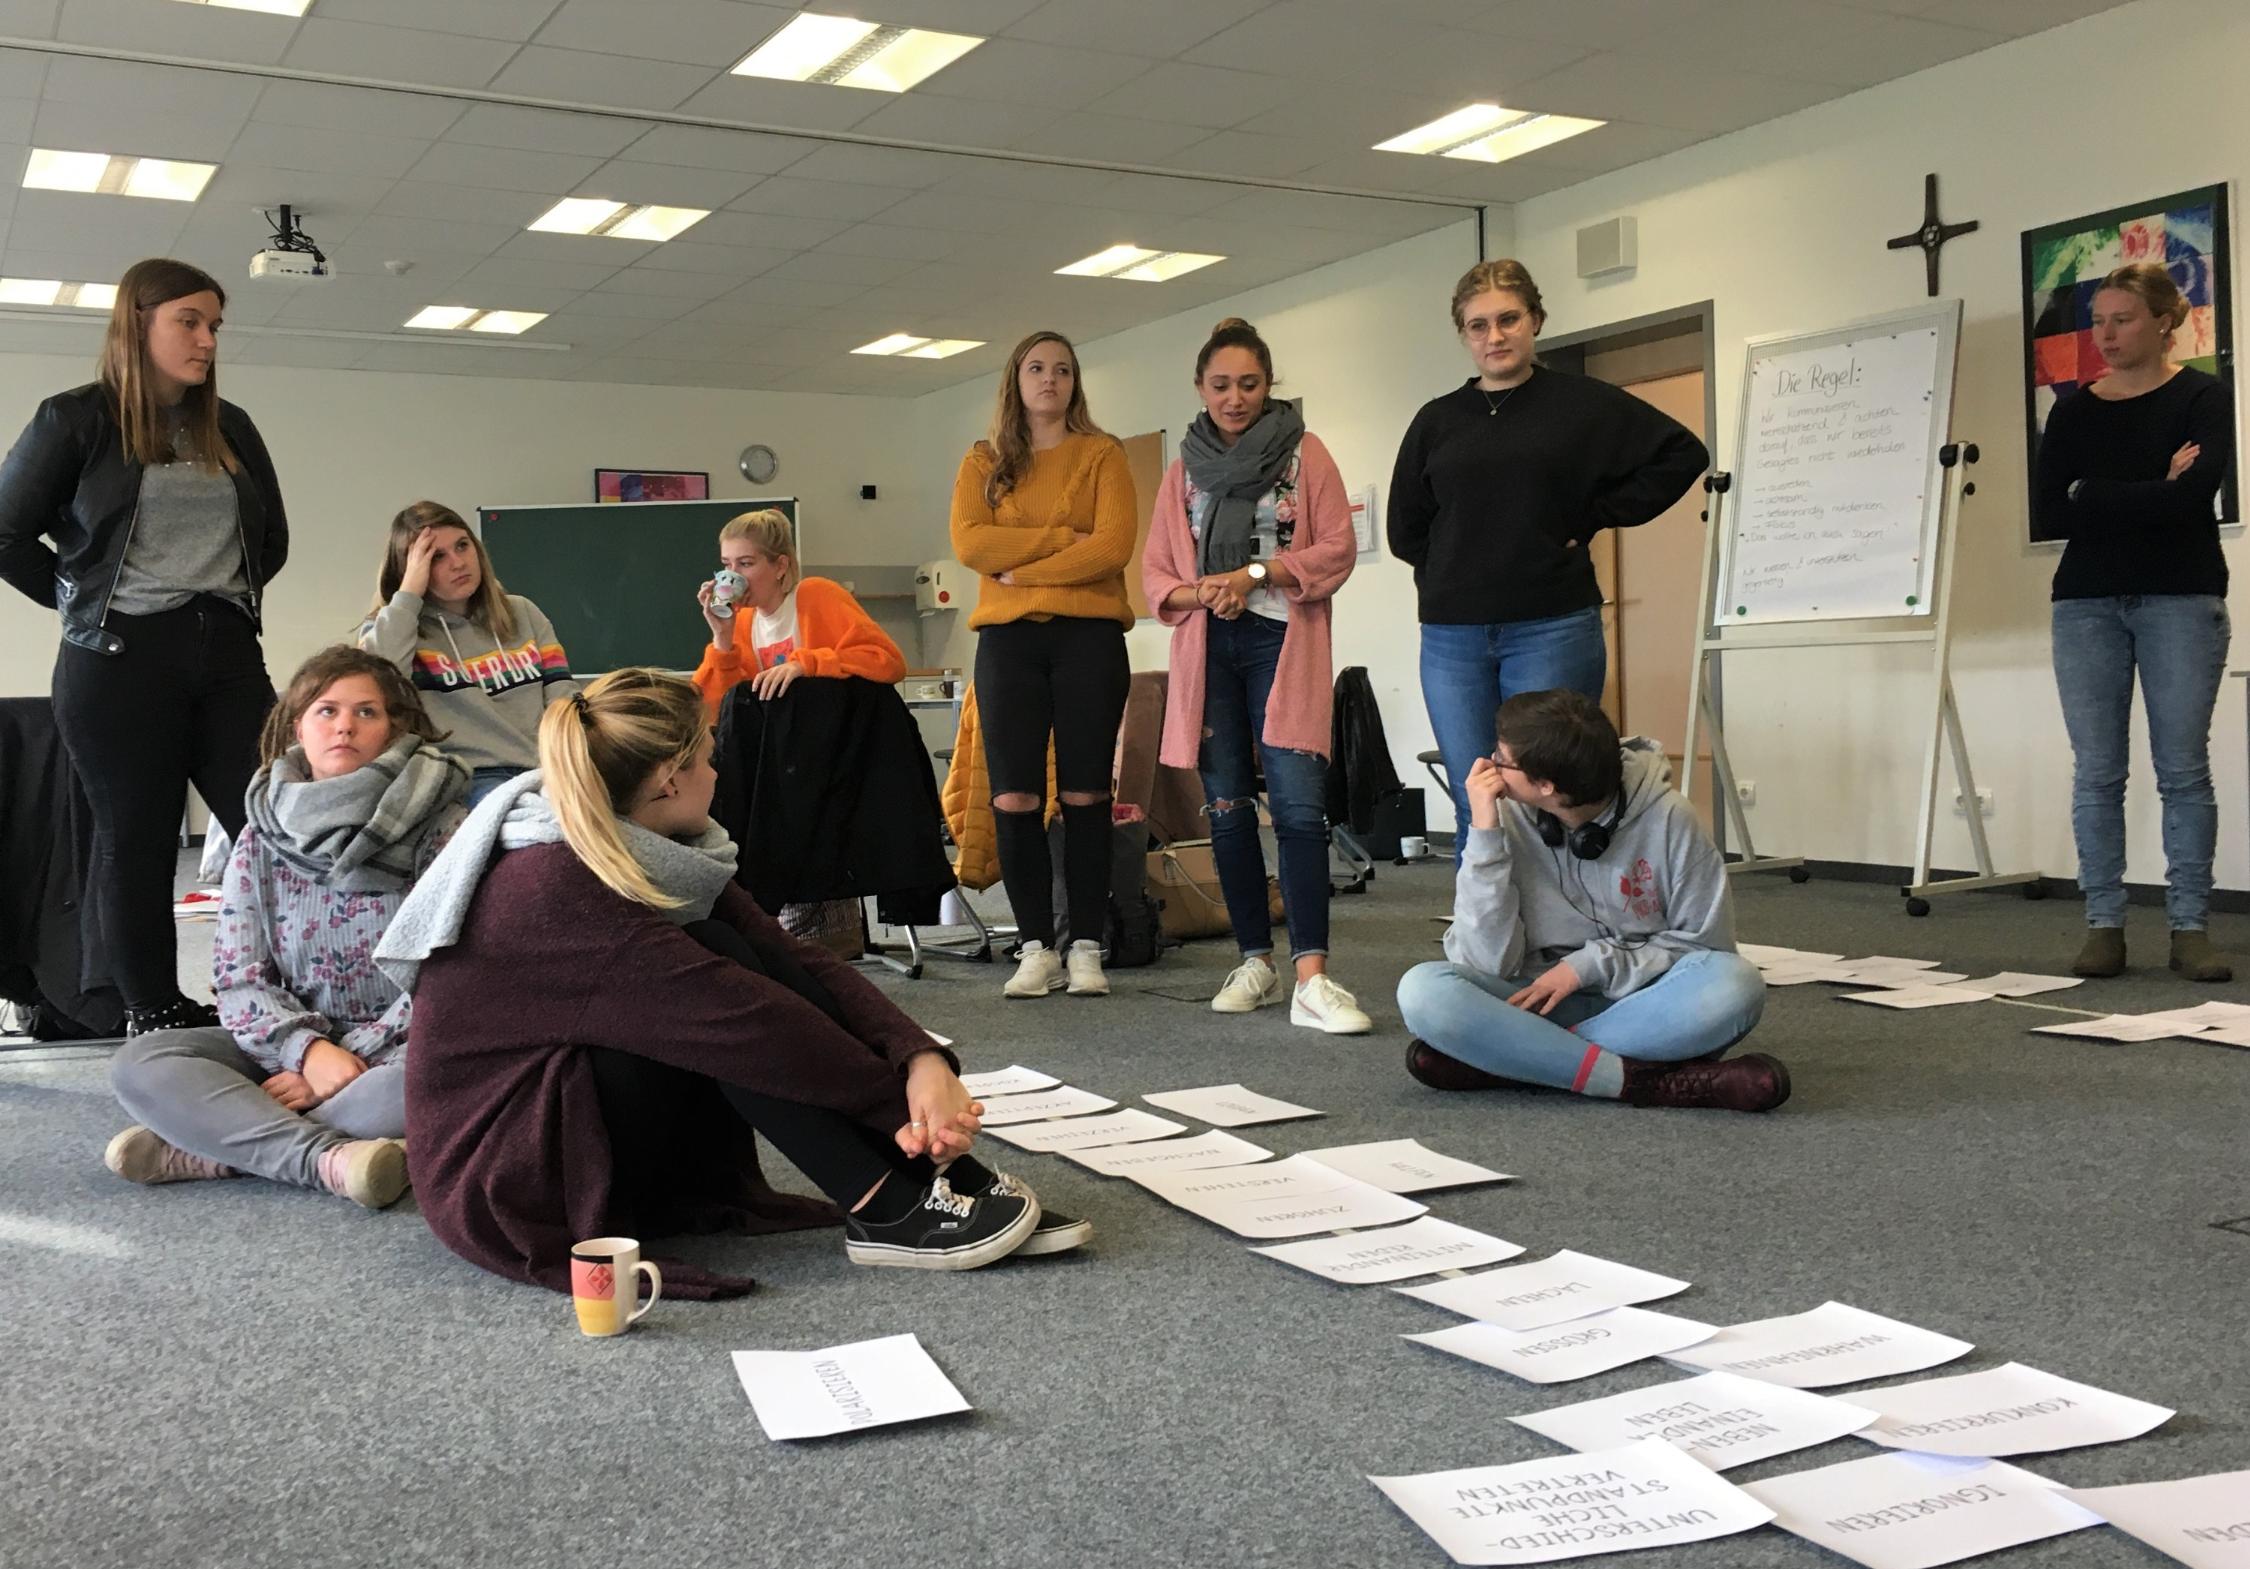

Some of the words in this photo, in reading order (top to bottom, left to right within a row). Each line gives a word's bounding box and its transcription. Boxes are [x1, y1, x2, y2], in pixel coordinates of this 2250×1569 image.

[1775, 369, 1802, 397] Die
[1808, 357, 1863, 398] Regel:
[1624, 1401, 1711, 1428] LEBEN
[1448, 1478, 1670, 1521] STANDPUNKTE
[1456, 1469, 1627, 1503] VERTRETEN
[1486, 1508, 1719, 1551] UNTERSCHIED-
[1531, 1504, 1630, 1528] LICHE
[1824, 1484, 2009, 1535] IGNORIEREN
